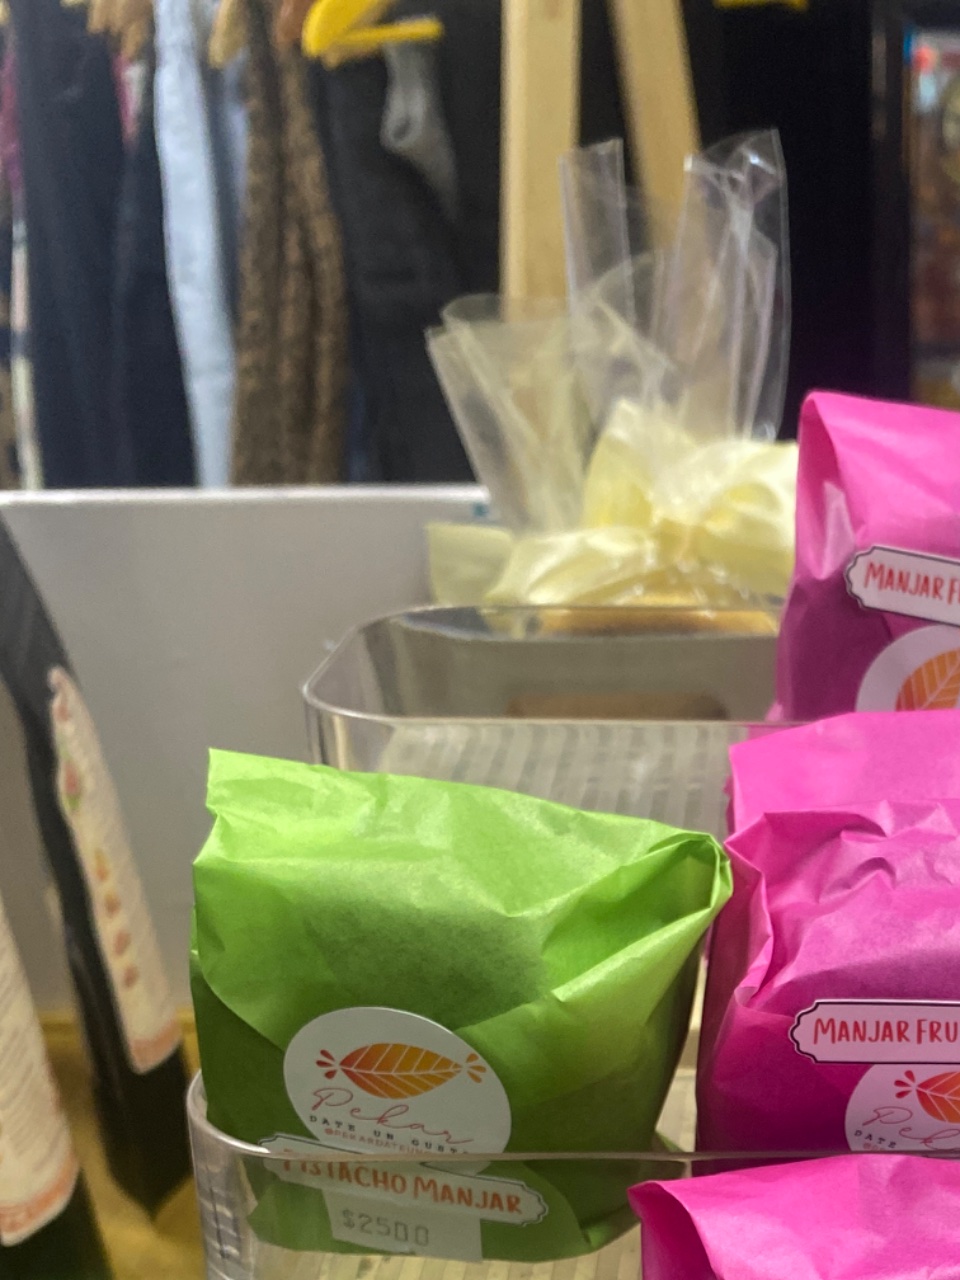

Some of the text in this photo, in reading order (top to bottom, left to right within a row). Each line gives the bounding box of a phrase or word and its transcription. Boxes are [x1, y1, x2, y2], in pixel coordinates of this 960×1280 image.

[864, 562, 944, 600] MANJAR
[813, 1017, 910, 1045] MANJAR
[309, 1114, 356, 1133] DATE
[854, 1129, 897, 1149] DATE
[413, 1176, 523, 1215] MANJAR
[341, 1209, 430, 1247] $2500
